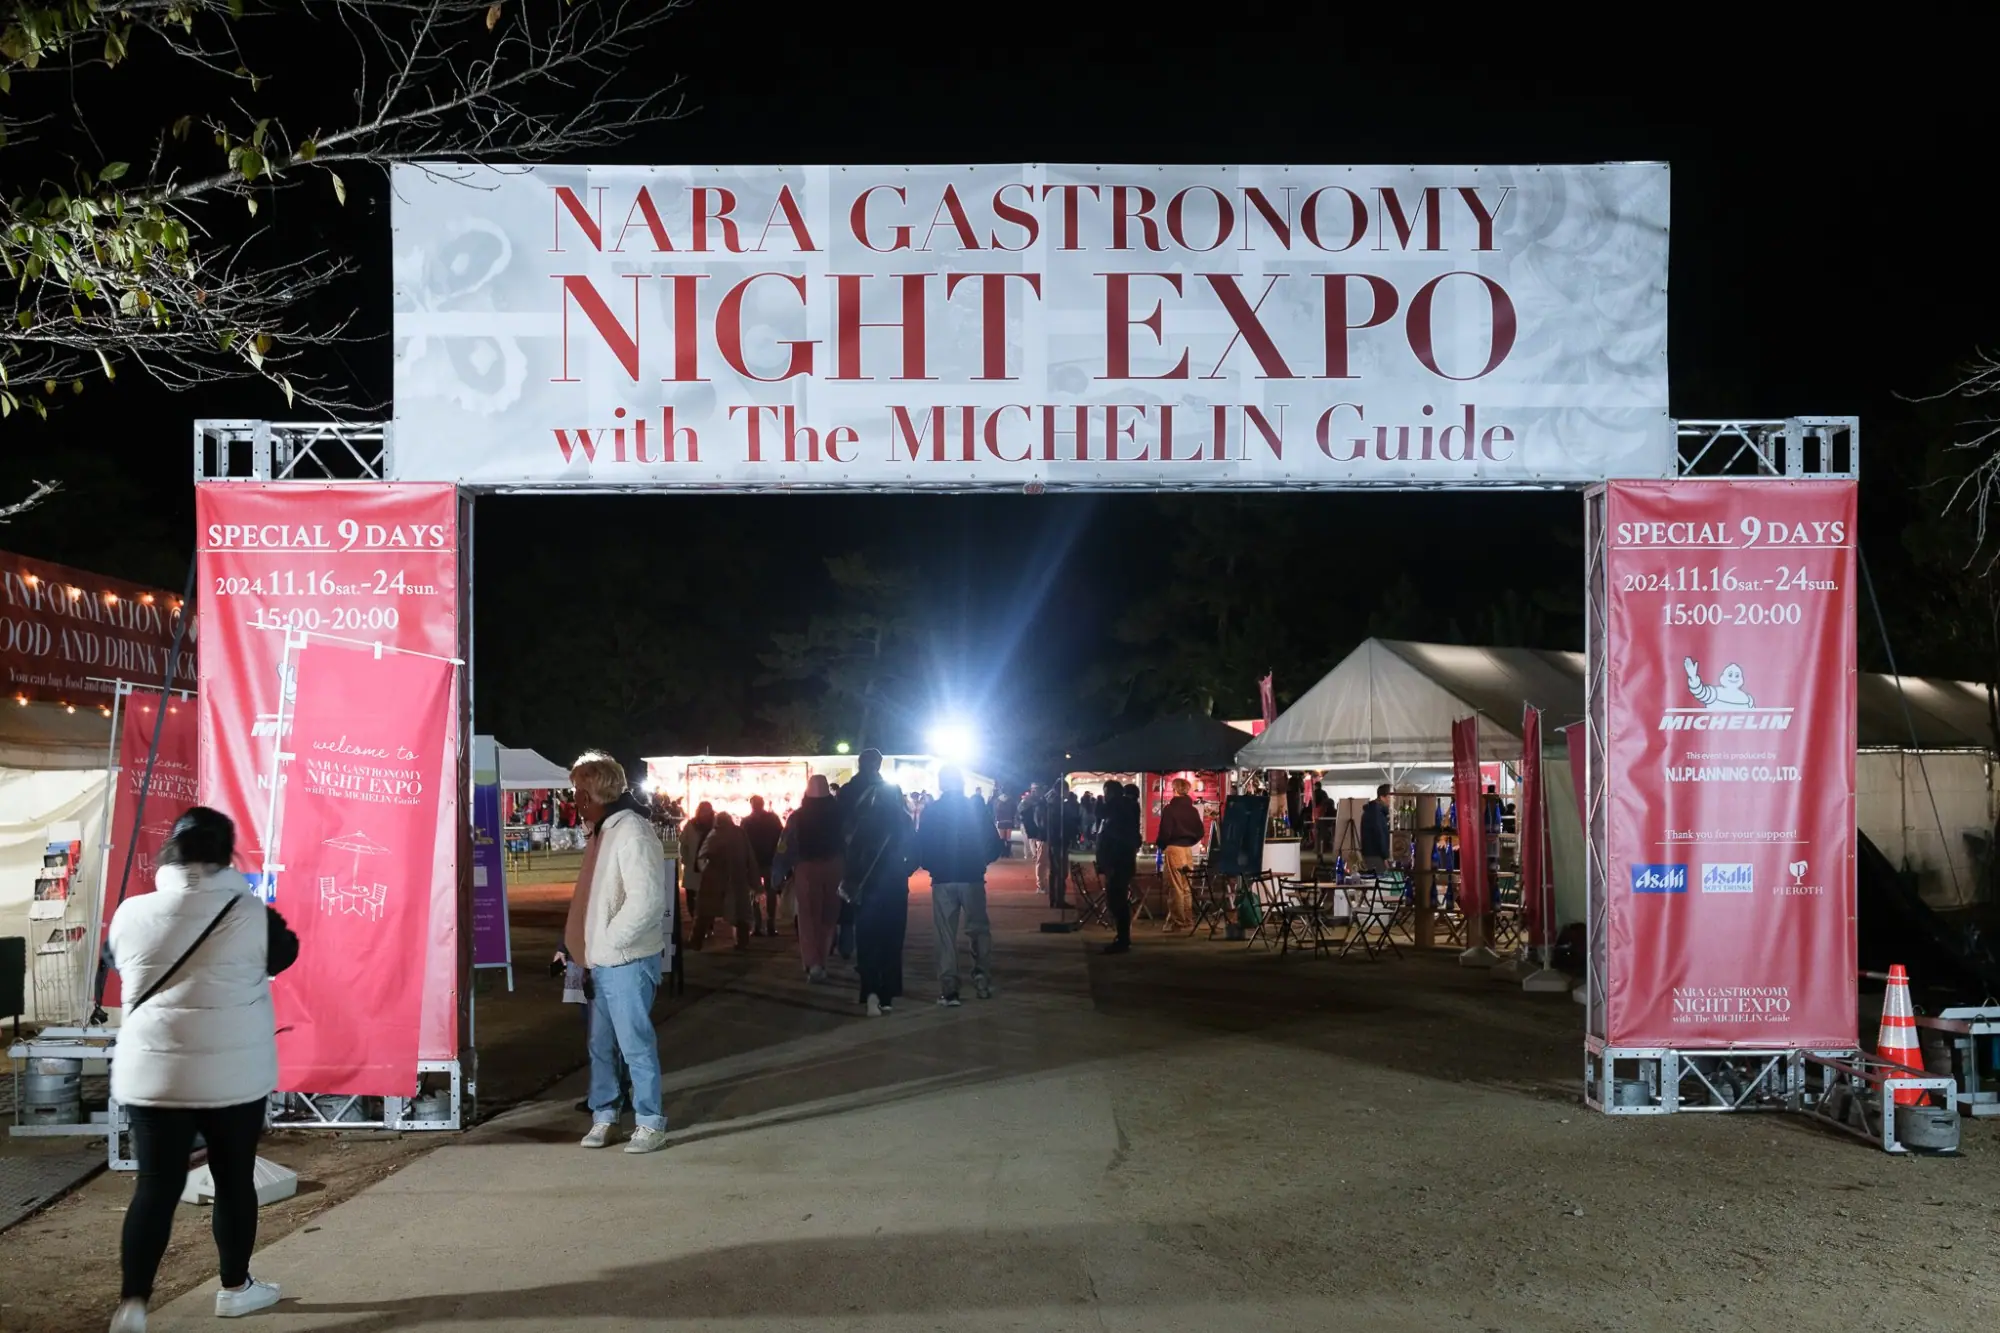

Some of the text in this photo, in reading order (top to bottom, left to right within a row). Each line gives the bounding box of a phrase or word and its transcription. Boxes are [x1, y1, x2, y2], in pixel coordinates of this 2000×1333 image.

[547, 182, 1518, 254] NARA GASTRONOMY
[549, 270, 1518, 383] NIGHT EXPO
[550, 402, 1516, 464] with The MICHELIN Guide
[208, 519, 445, 552] SPECIAL 9 DAYS
[1617, 516, 1845, 549] SPECIAL 9 DAYS
[3, 571, 163, 635] INFORMATION
[1662, 603, 1802, 626] 15:00-20:00
[255, 607, 400, 630] 15:00-20:00
[56, 627, 100, 665] AND
[104, 635, 158, 676] DRINK
[9, 666, 28, 683] You
[30, 674, 46, 685] can
[65, 673, 83, 690] food
[1658, 714, 1793, 730] MICHELIN
[312, 735, 420, 760] welcome to
[1686, 752, 1700, 760] This
[1701, 752, 1721, 760] event
[1731, 752, 1765, 761] produced
[306, 758, 340, 772] NARA
[343, 763, 423, 780] GASTRONOMY
[305, 769, 364, 791] NIGHT
[369, 777, 423, 796] EXPO
[327, 787, 342, 798] The
[344, 790, 392, 804] MICHELIN
[1665, 829, 1797, 841] Thank you for your support!
[1635, 868, 1685, 889] Asahi
[1703, 865, 1752, 885] Asahi
[1772, 886, 1824, 895] PIEROTH
[1672, 986, 1790, 998] NARA GASTRONOMY
[1672, 997, 1791, 1013] NIGHT EXPO
[1672, 1013, 1791, 1023] with The MICHELIN Guide
